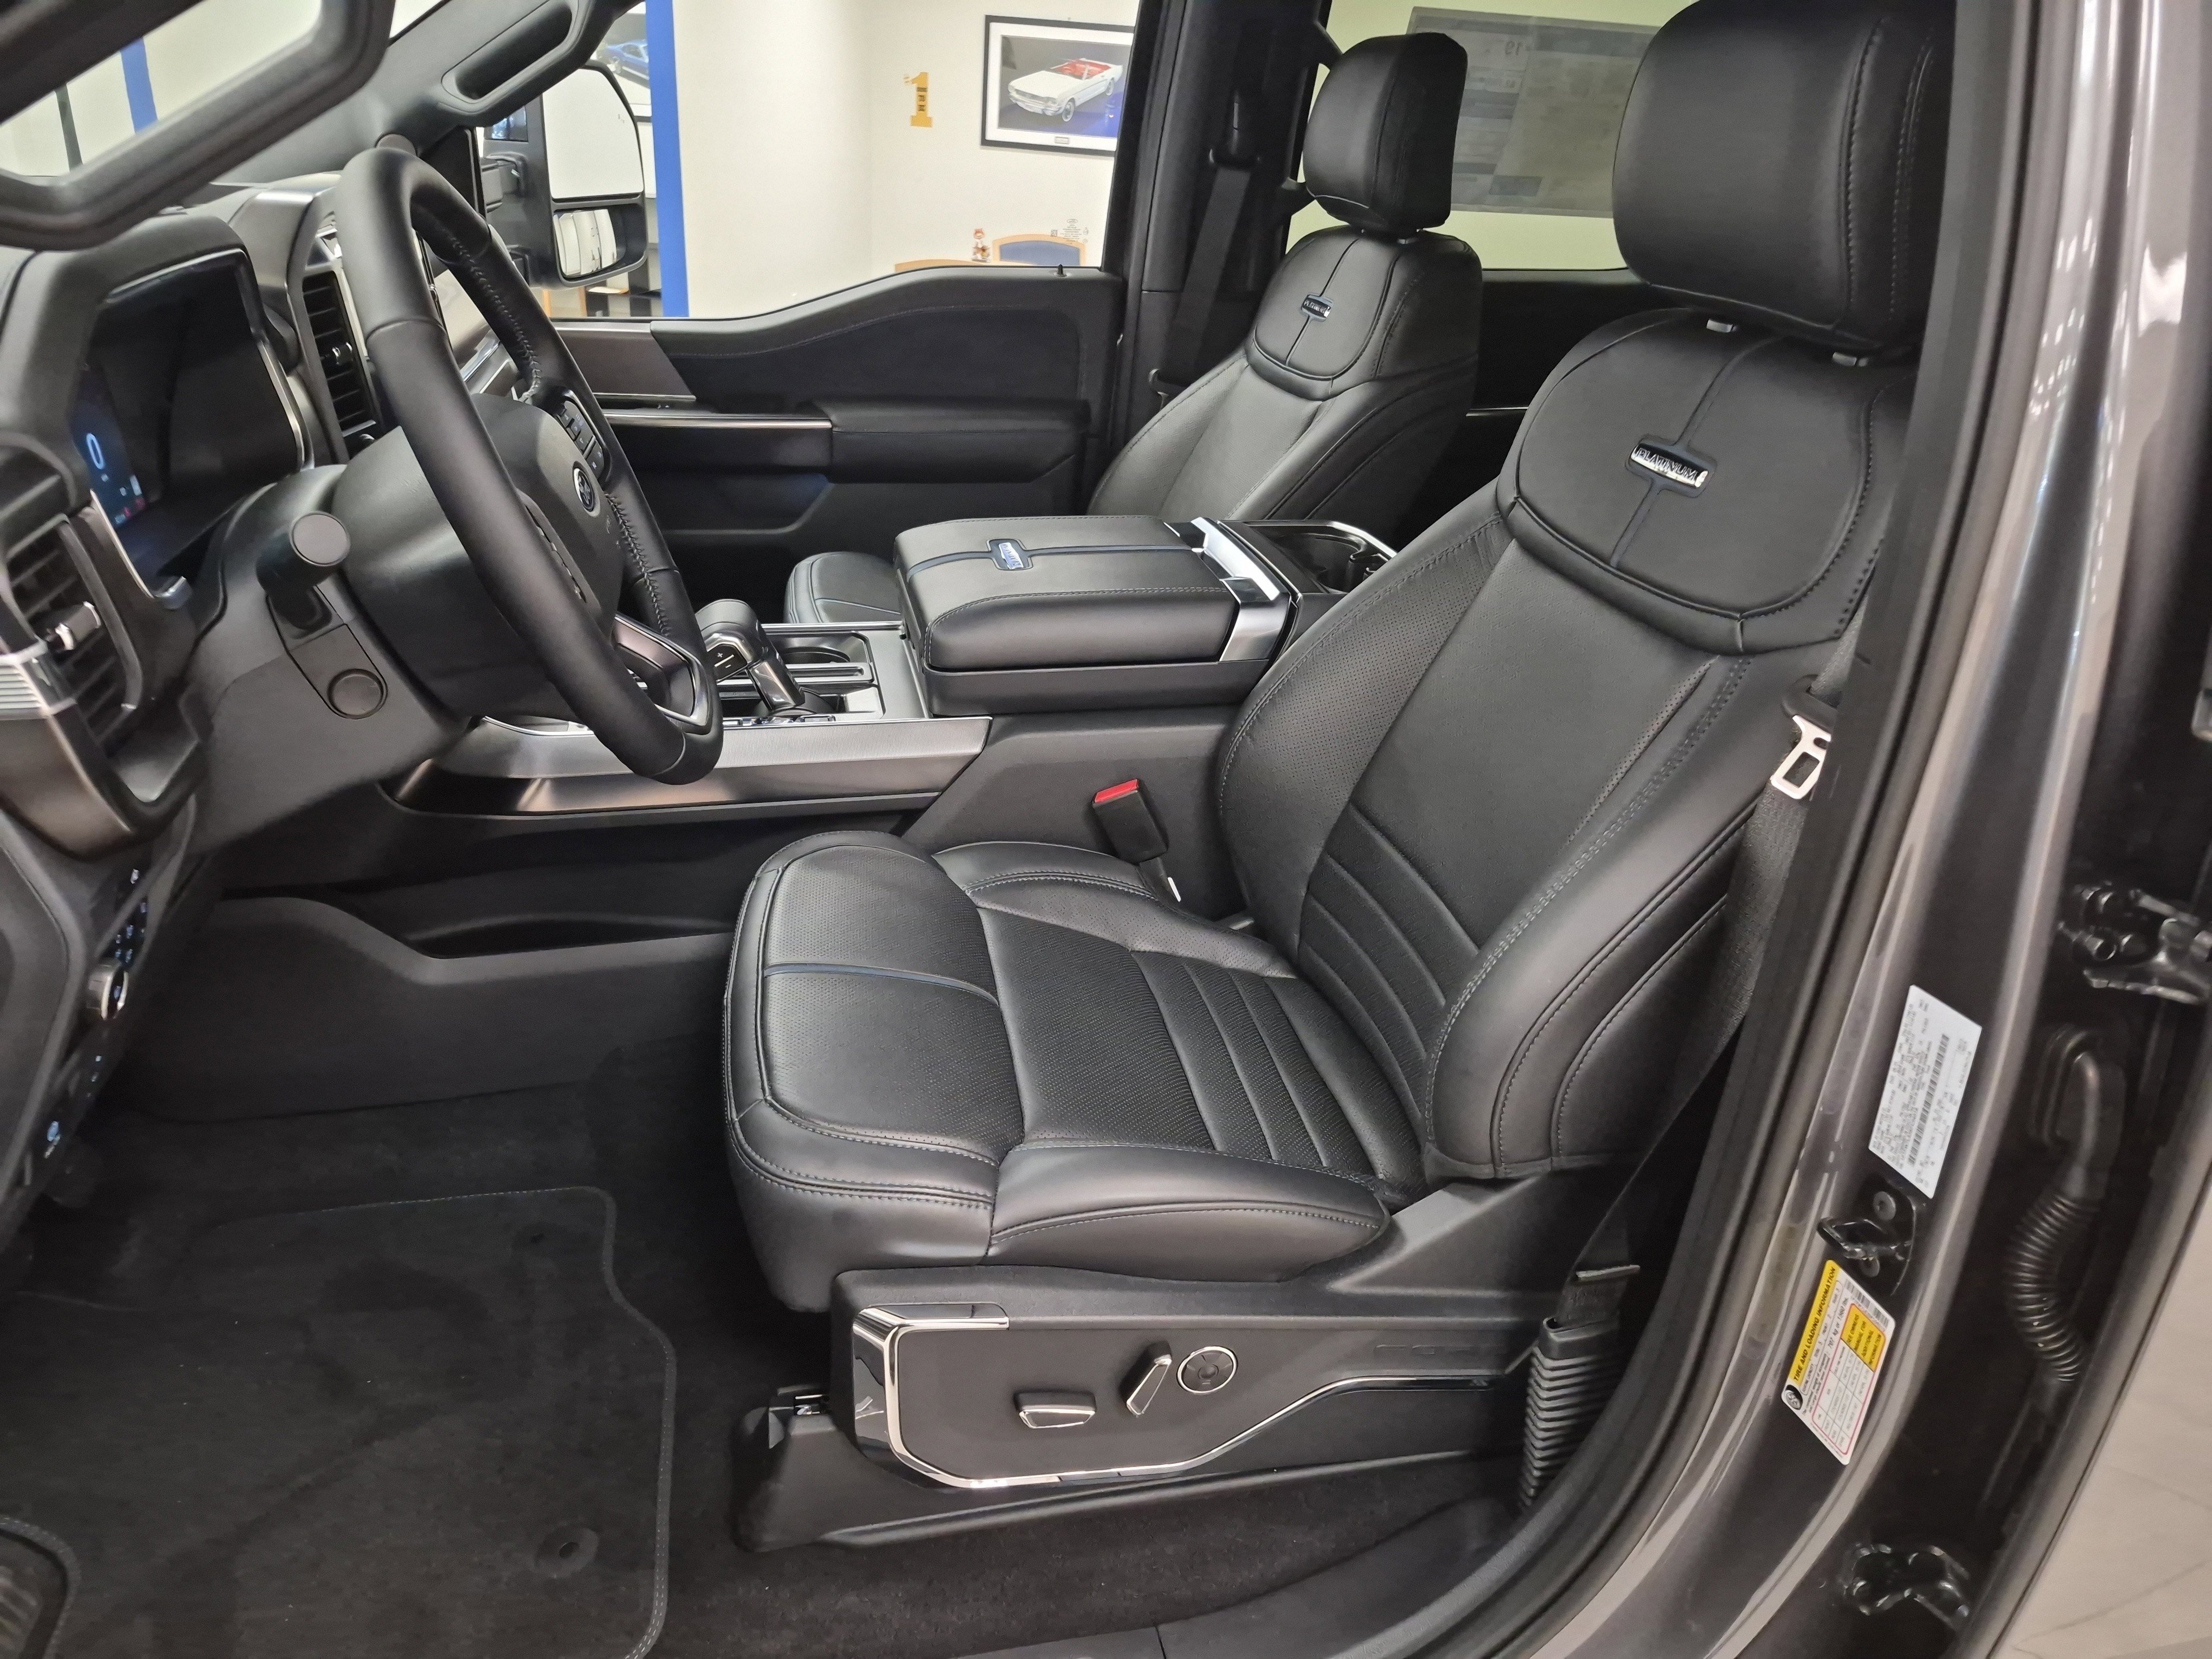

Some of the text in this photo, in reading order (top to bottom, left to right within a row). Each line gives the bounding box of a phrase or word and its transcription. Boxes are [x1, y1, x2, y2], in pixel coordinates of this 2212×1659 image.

[86, 433, 106, 470] 0
[1637, 448, 1698, 481] PLATINUM
[1793, 1364, 1803, 1381] TIRE
[1800, 1351, 1808, 1364] AND
[1805, 1317, 1819, 1348] LOADING
[1817, 1267, 1836, 1317] INFORMATION
